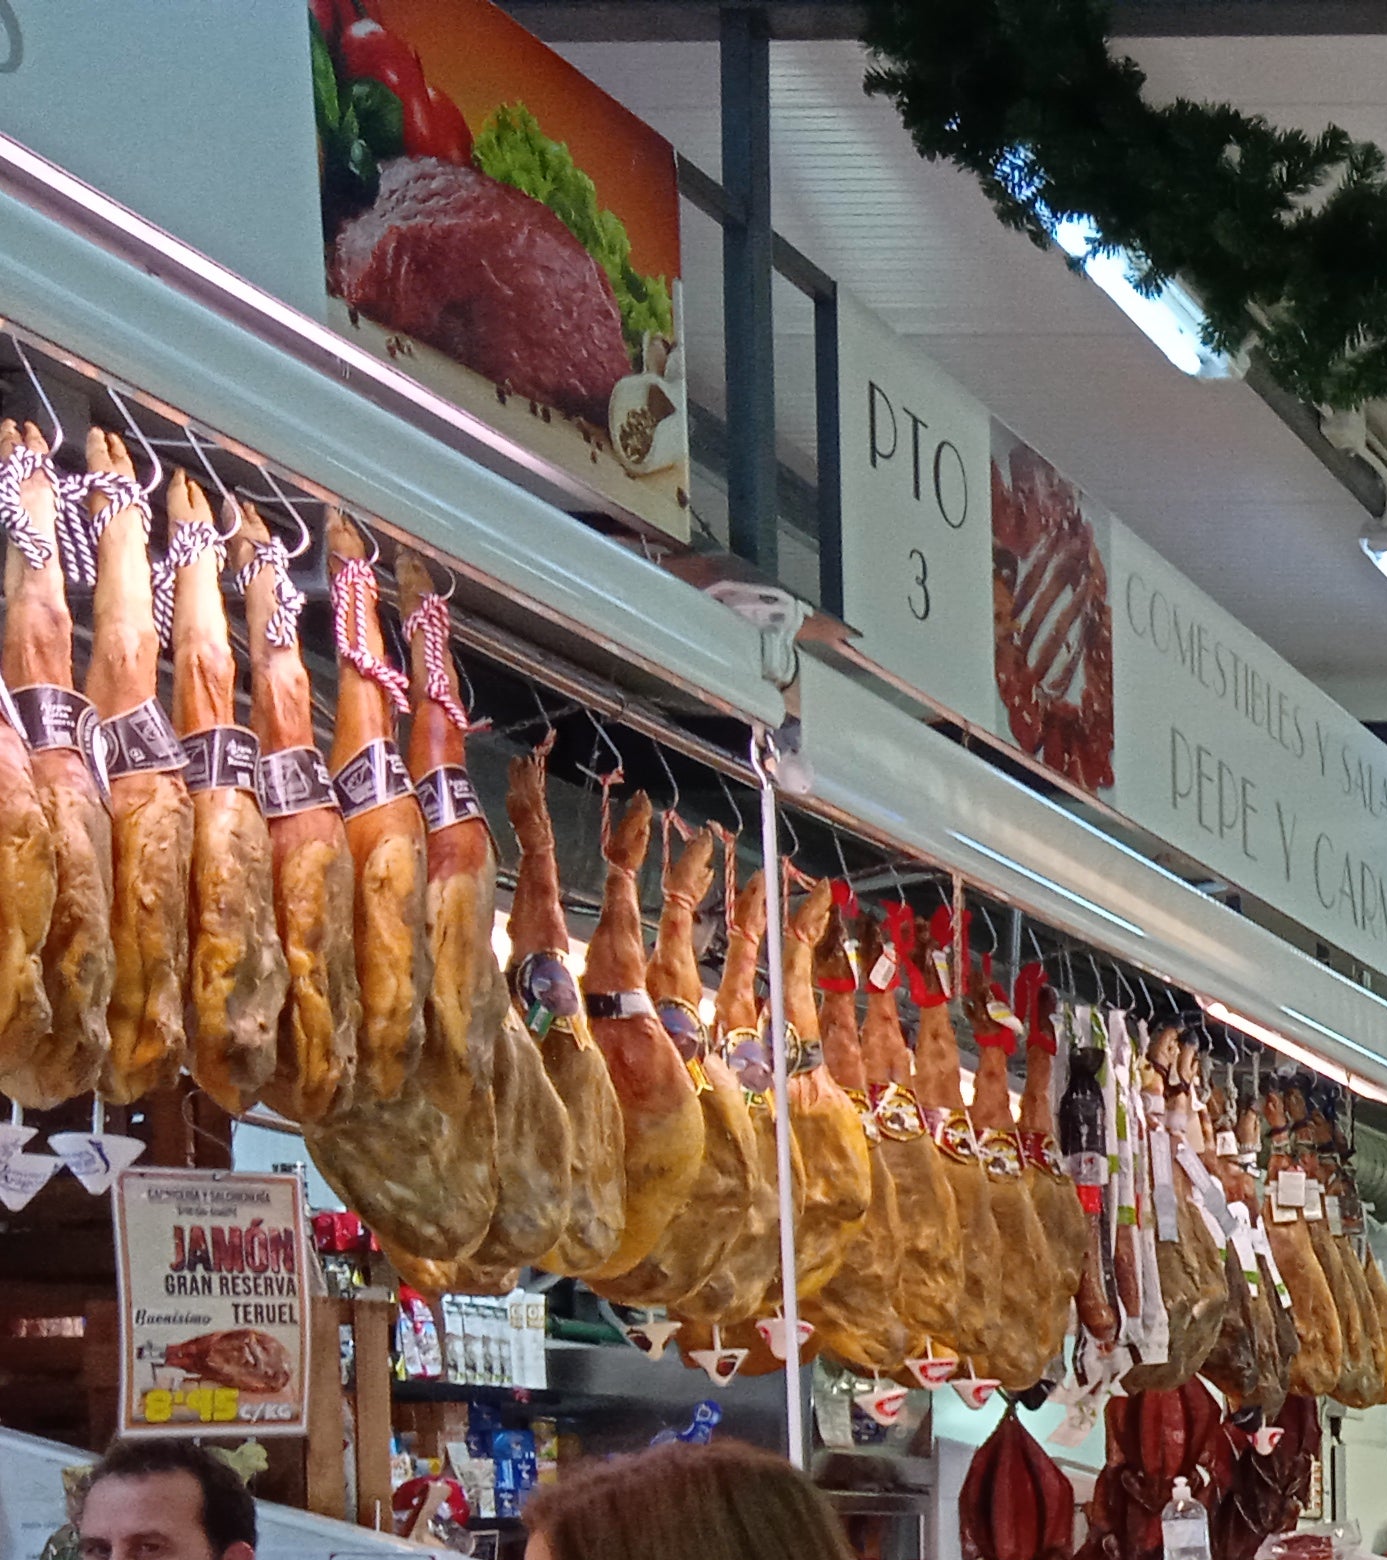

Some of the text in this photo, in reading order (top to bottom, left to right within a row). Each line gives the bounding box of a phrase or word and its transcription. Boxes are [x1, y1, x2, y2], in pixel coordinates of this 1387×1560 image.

[868, 381, 968, 528] PTO
[906, 548, 931, 621] 3
[1126, 572, 1306, 759] COMESTIBLES
[1313, 720, 1331, 777] Y
[1170, 726, 1259, 861] PEPE
[1275, 801, 1297, 882] Y
[169, 1218, 296, 1275] JAMÓN
[164, 1274, 298, 1298] GRAN RESERVA
[231, 1303, 299, 1325] TERUEL
